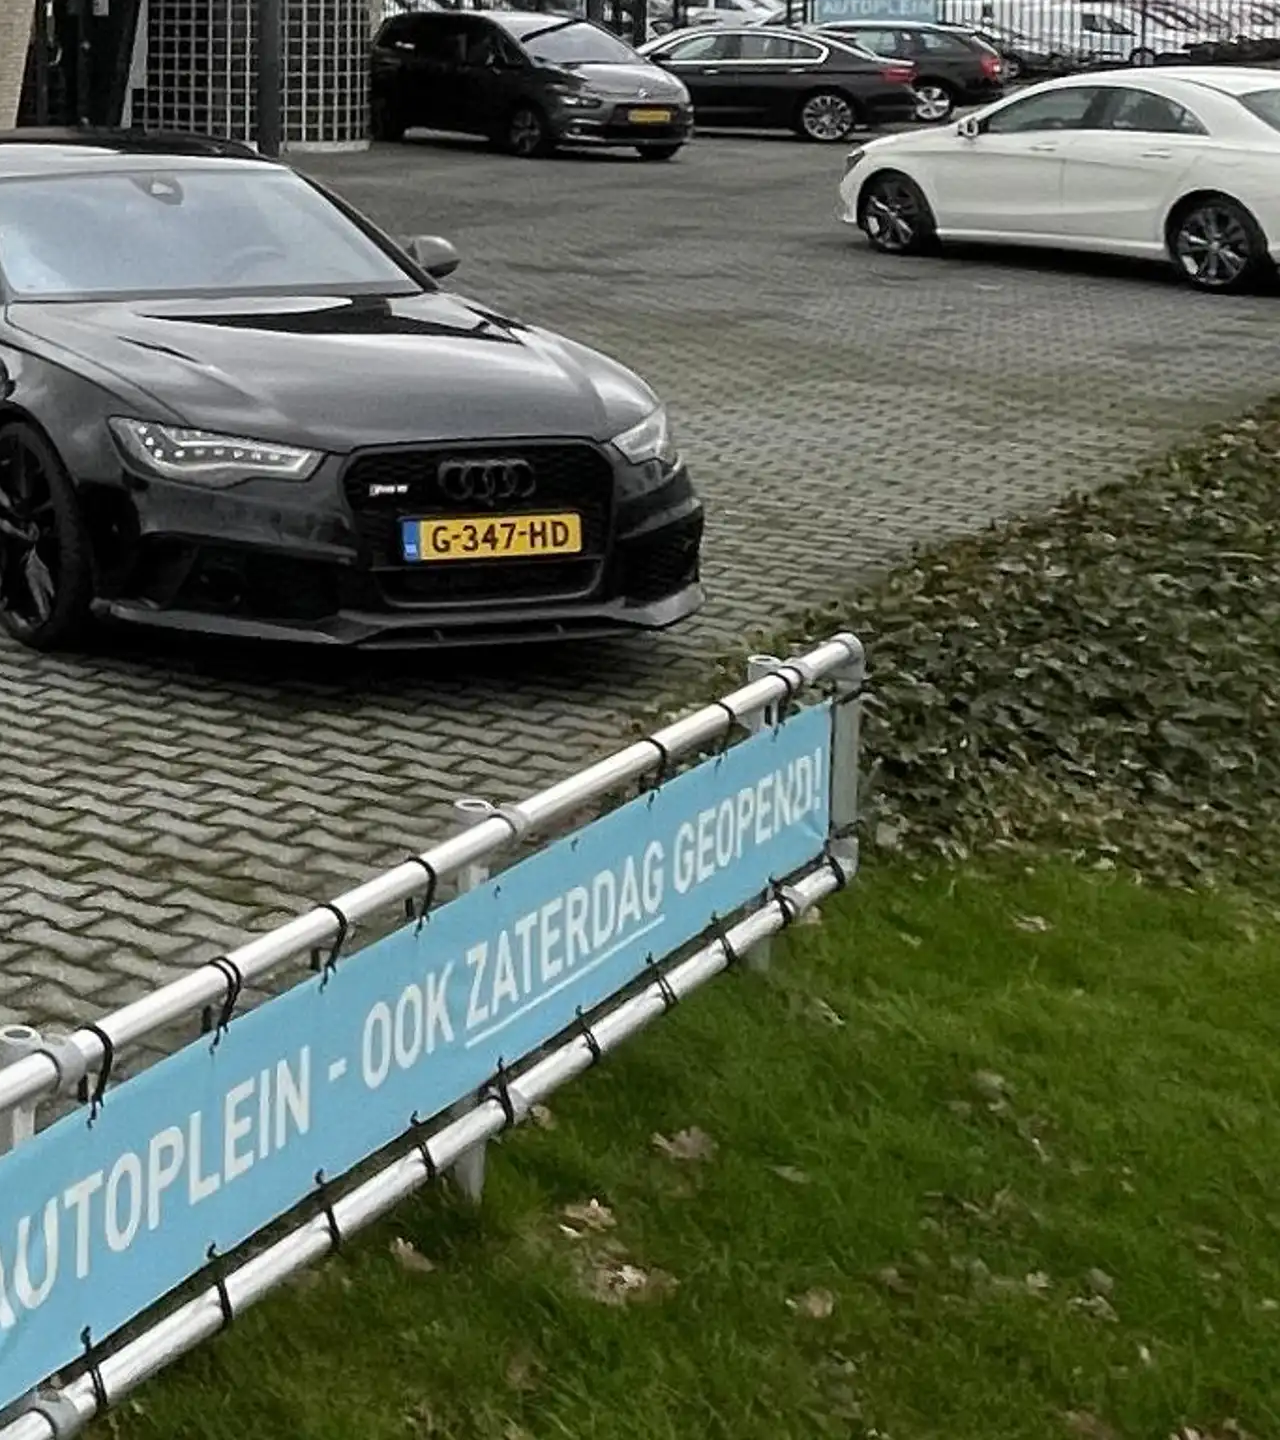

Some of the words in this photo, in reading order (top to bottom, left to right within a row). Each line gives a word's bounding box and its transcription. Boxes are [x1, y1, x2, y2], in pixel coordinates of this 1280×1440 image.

[822, 0, 934, 16] AUTOPLEIN
[431, 520, 569, 553] G-347-HD
[362, 960, 455, 1090] OOK
[465, 839, 666, 1031] ZATERDAG
[672, 746, 824, 895] GEOPEND!
